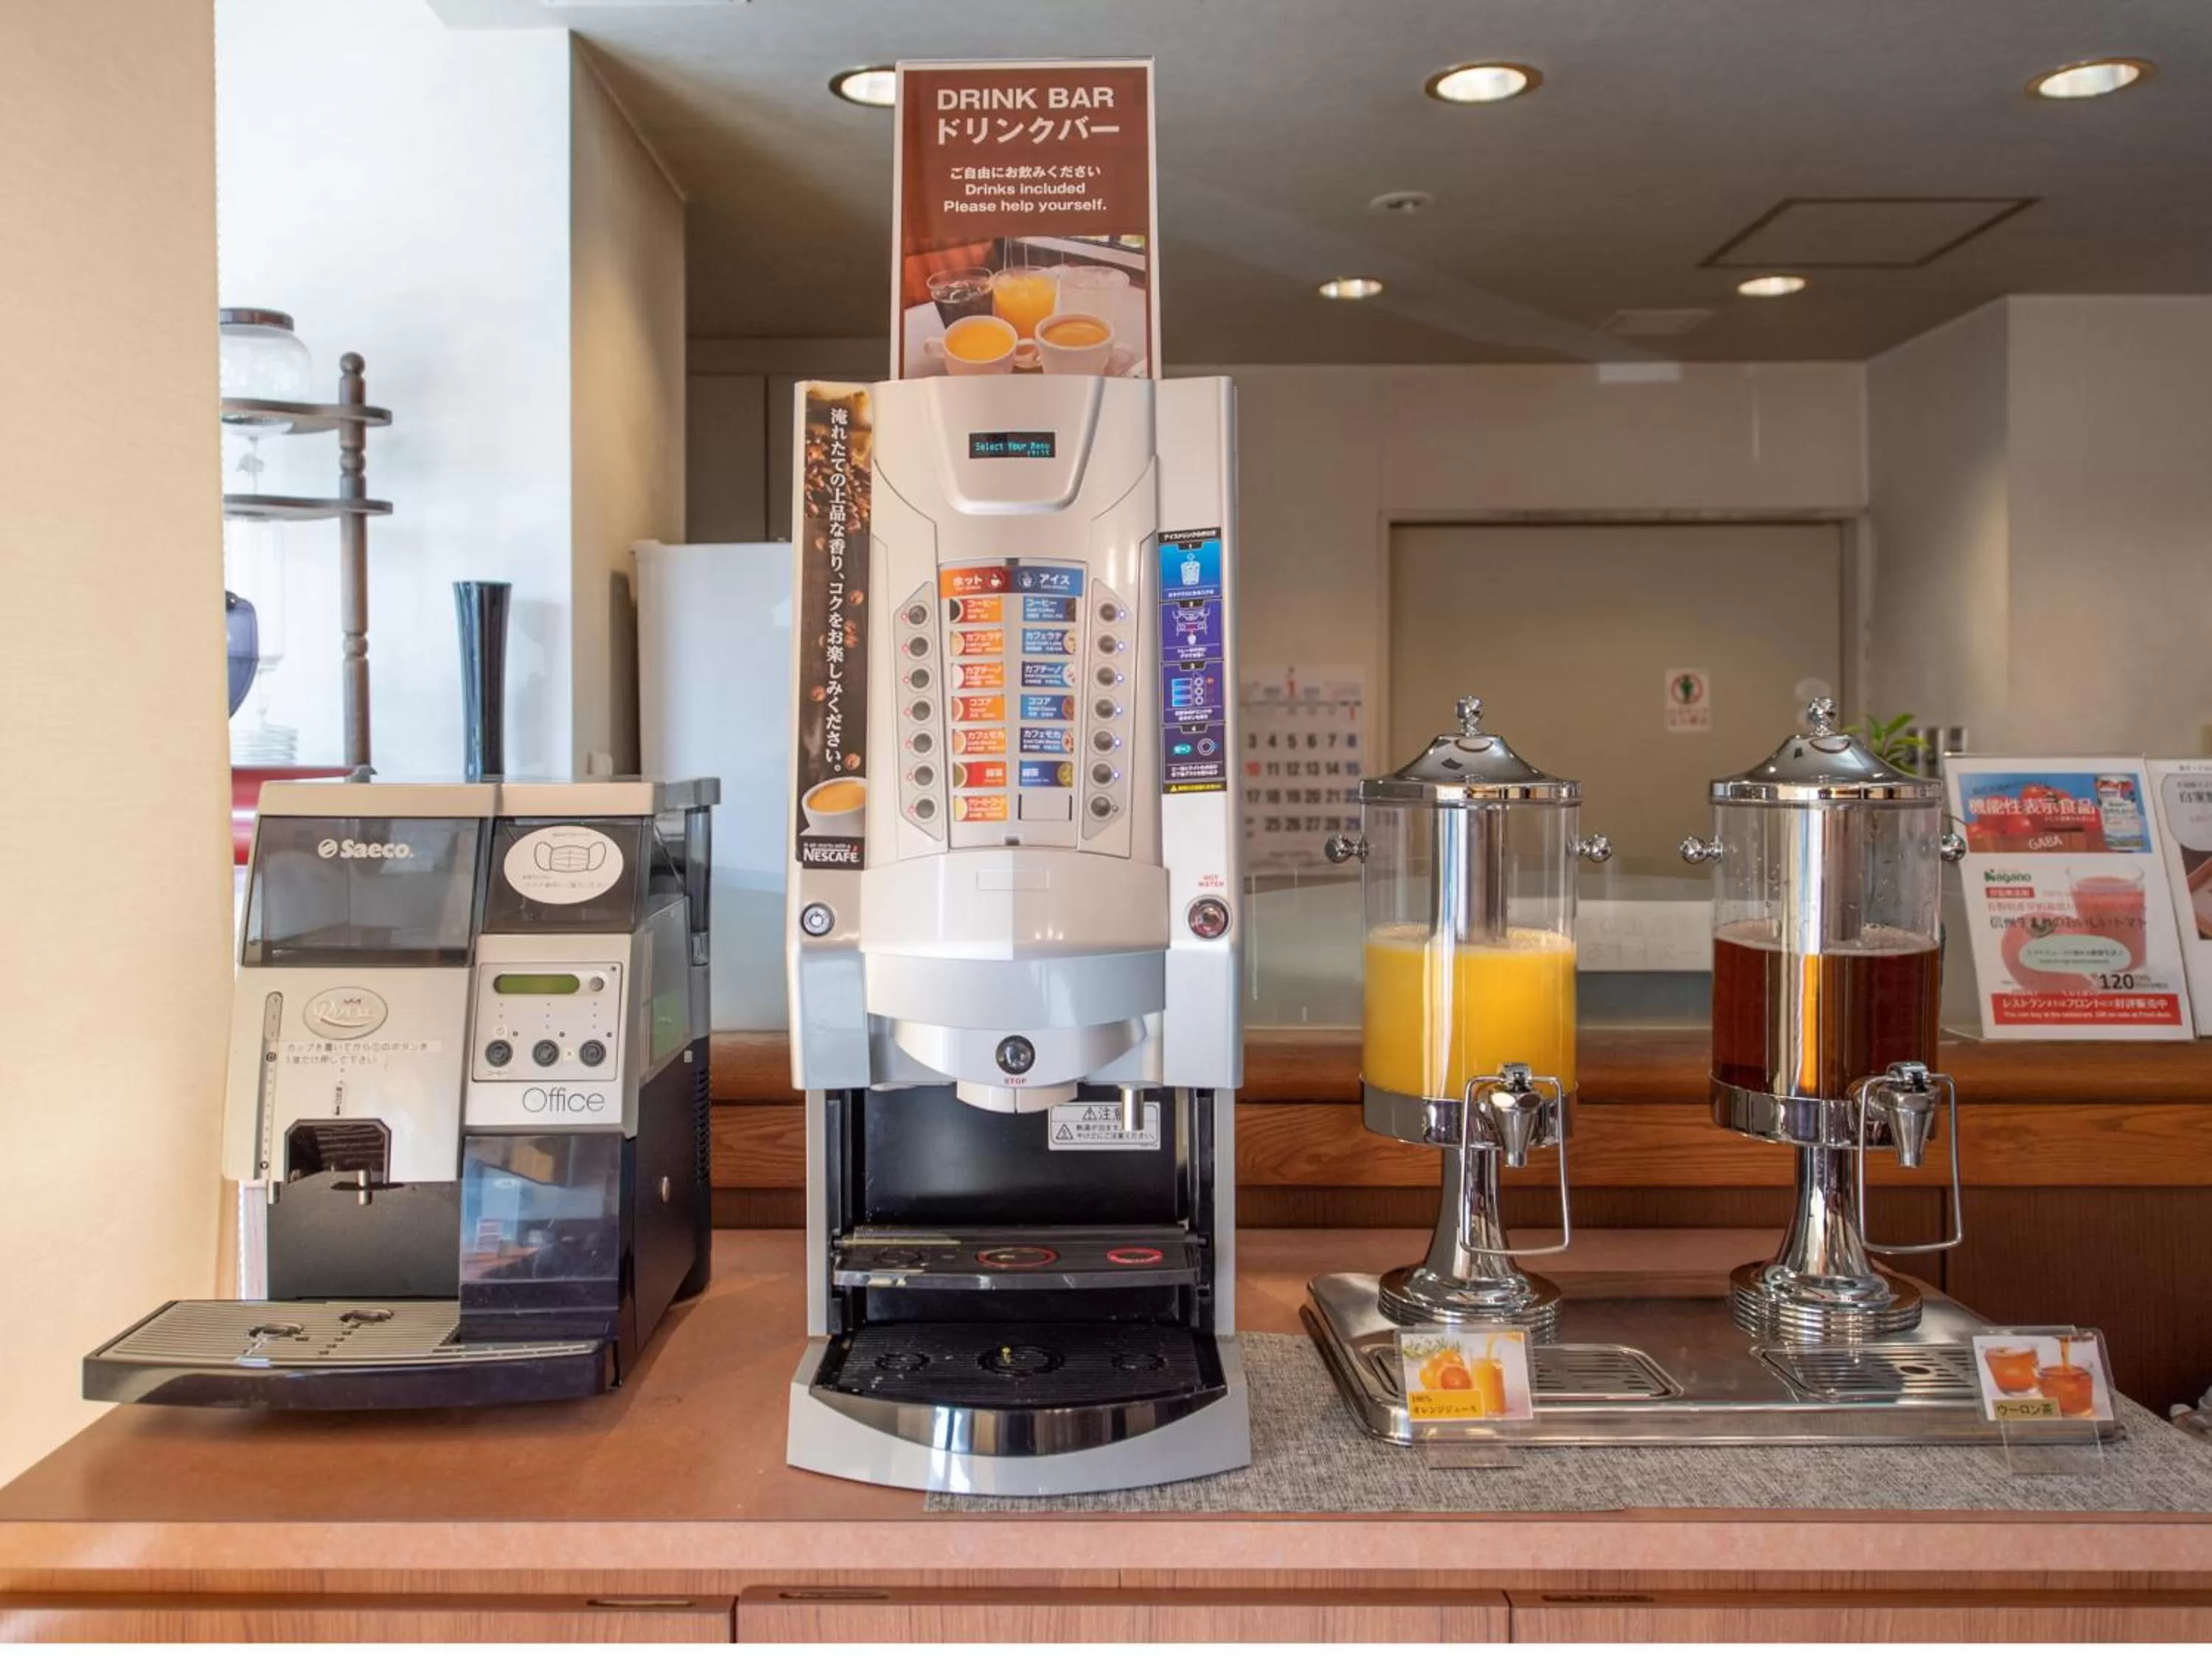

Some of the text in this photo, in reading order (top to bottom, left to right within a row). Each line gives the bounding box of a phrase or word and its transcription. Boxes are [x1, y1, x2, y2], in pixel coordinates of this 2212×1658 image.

[937, 87, 1114, 110] DRINK BAR
[937, 116, 1120, 145] ドリンクバー
[950, 165, 1102, 180] ご自由にお飲みください
[965, 182, 1085, 195] Drinks included
[944, 198, 1107, 212] Please help yourself.
[975, 442, 1004, 451] Select
[1008, 441, 1027, 451] Your
[953, 575, 983, 586] ホット
[1039, 573, 1071, 584] アイス
[967, 599, 998, 608] コーヒー
[1026, 598, 1058, 607] コーヒー
[1026, 631, 1062, 640] カフェラテ
[1025, 665, 1062, 674] カプチーノ
[1027, 697, 1051, 706] ココア
[1023, 729, 1061, 738] カフェモカ
[1968, 797, 2096, 815] 機能性表示食品
[341, 839, 410, 859] Saeco
[2028, 836, 2063, 850] GABA
[2100, 974, 2135, 990] 120
[522, 1086, 605, 1113] Office
[1413, 1404, 1478, 1415] オレンジジュース
[1997, 1404, 2053, 1416] ウーロン茶
